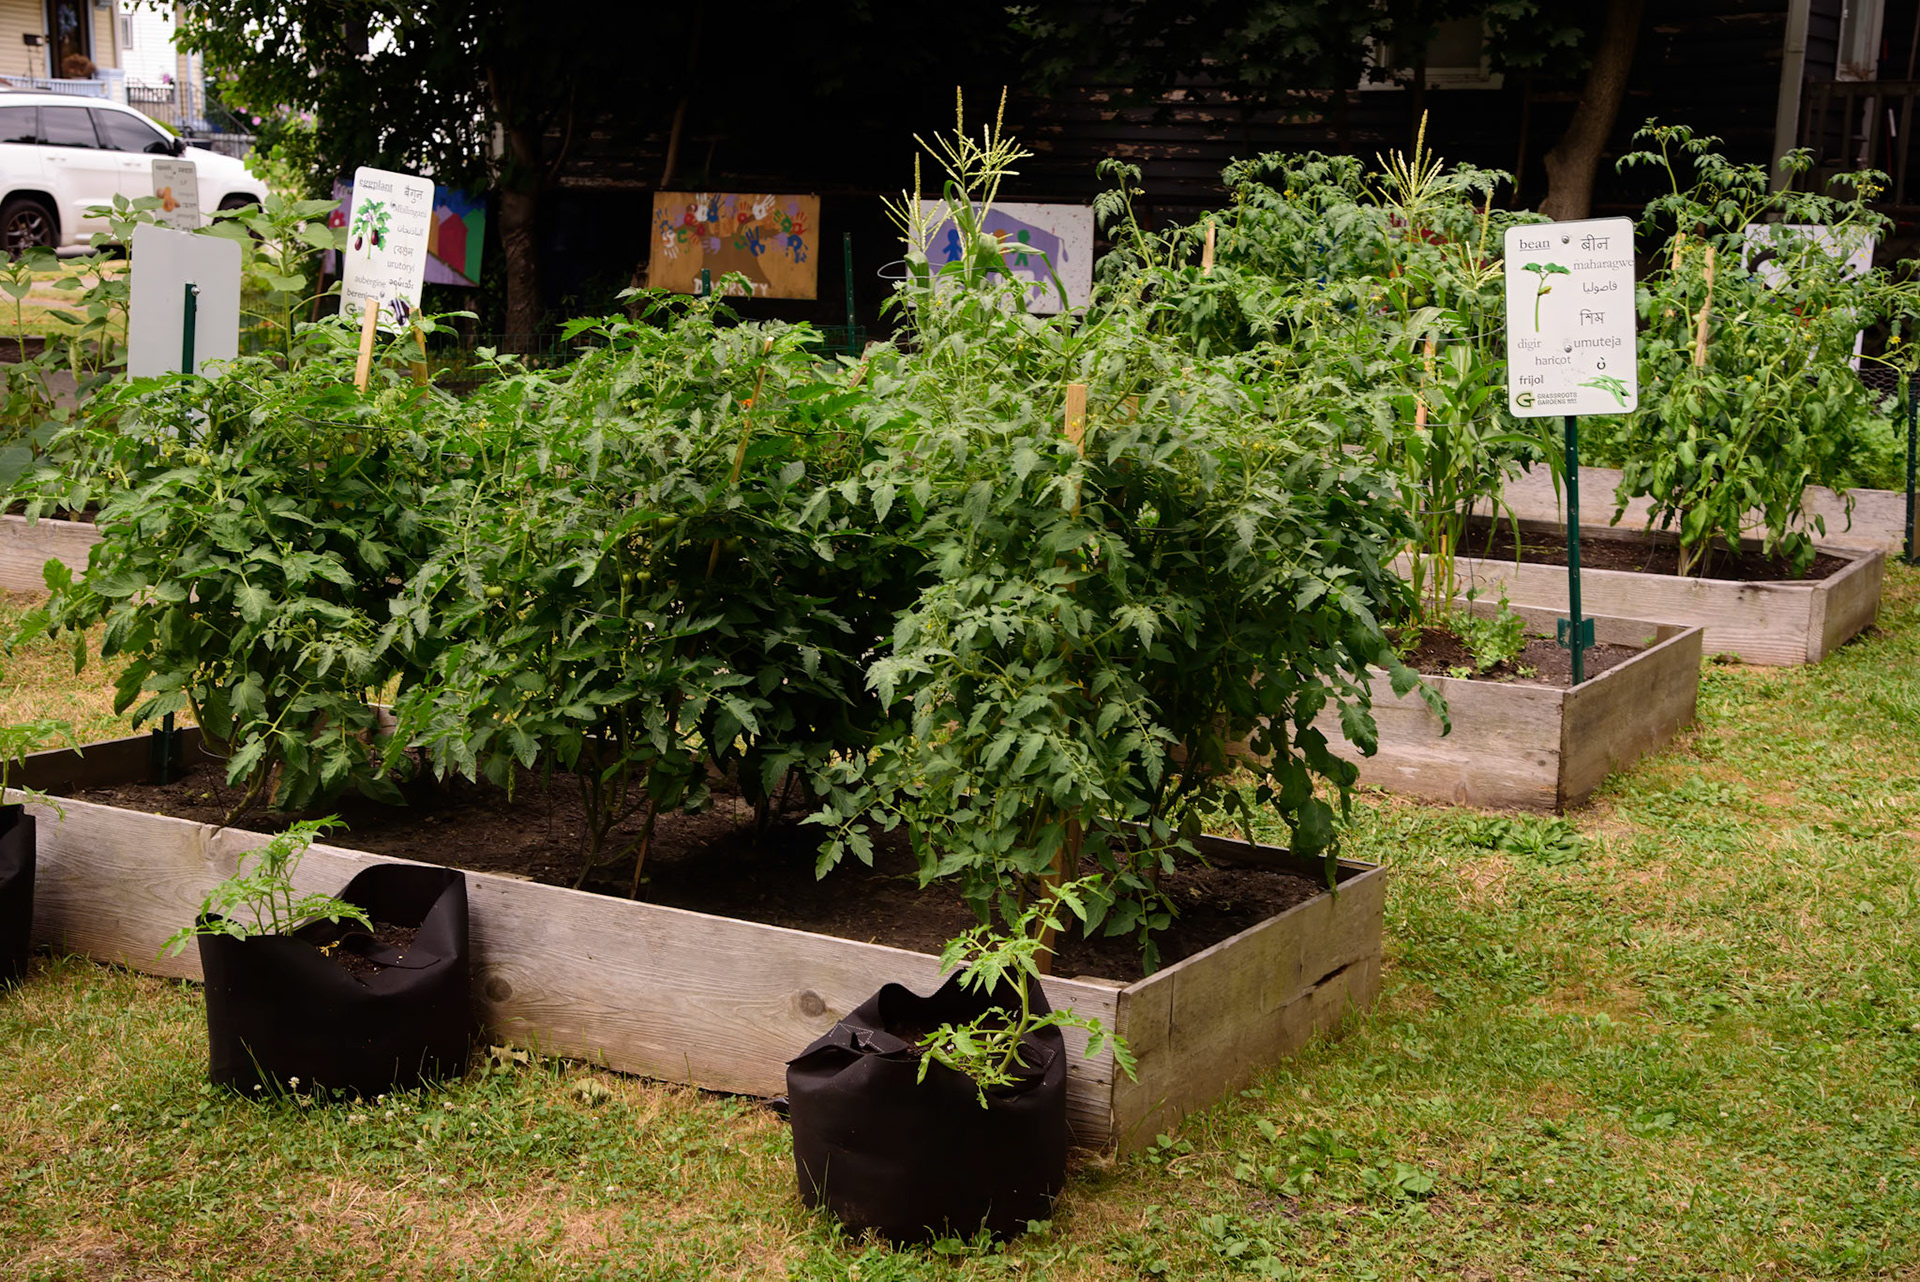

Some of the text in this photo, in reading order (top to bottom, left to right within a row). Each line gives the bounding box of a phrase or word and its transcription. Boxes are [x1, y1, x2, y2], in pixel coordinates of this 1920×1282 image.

[359, 178, 393, 193] eggplant
[1519, 239, 1550, 251] bean
[1580, 233, 1611, 251] बीन
[1573, 258, 1634, 271] maharagwe
[354, 275, 386, 289] aubergine
[694, 277, 769, 297] DVRSTY
[1580, 308, 1606, 326] শিম
[1517, 338, 1542, 351] digir
[1573, 336, 1621, 349] umuteja
[1535, 355, 1571, 366] haricot
[1519, 374, 1544, 386] frijol
[1537, 392, 1577, 400] GRASSROOTS
